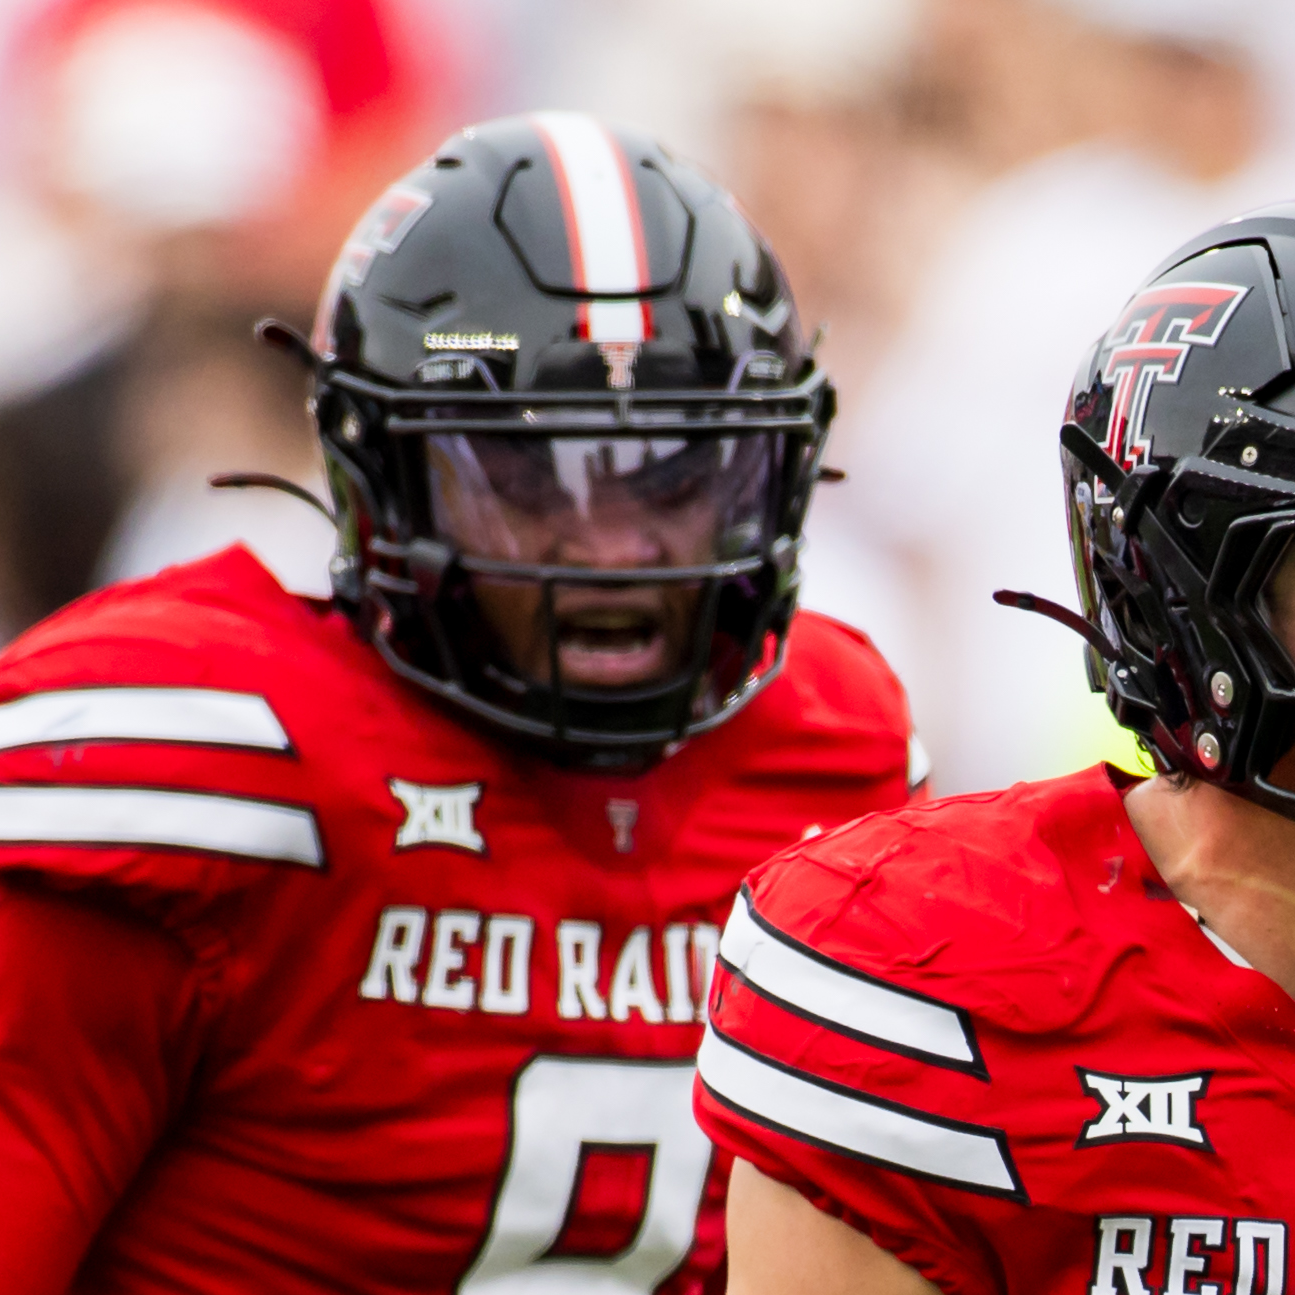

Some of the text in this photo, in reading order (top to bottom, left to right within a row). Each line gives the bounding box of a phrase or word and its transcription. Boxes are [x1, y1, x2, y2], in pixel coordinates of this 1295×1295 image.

[388, 776, 489, 855] XII
[359, 904, 534, 1016] RED
[1085, 1071, 1206, 1145] XII
